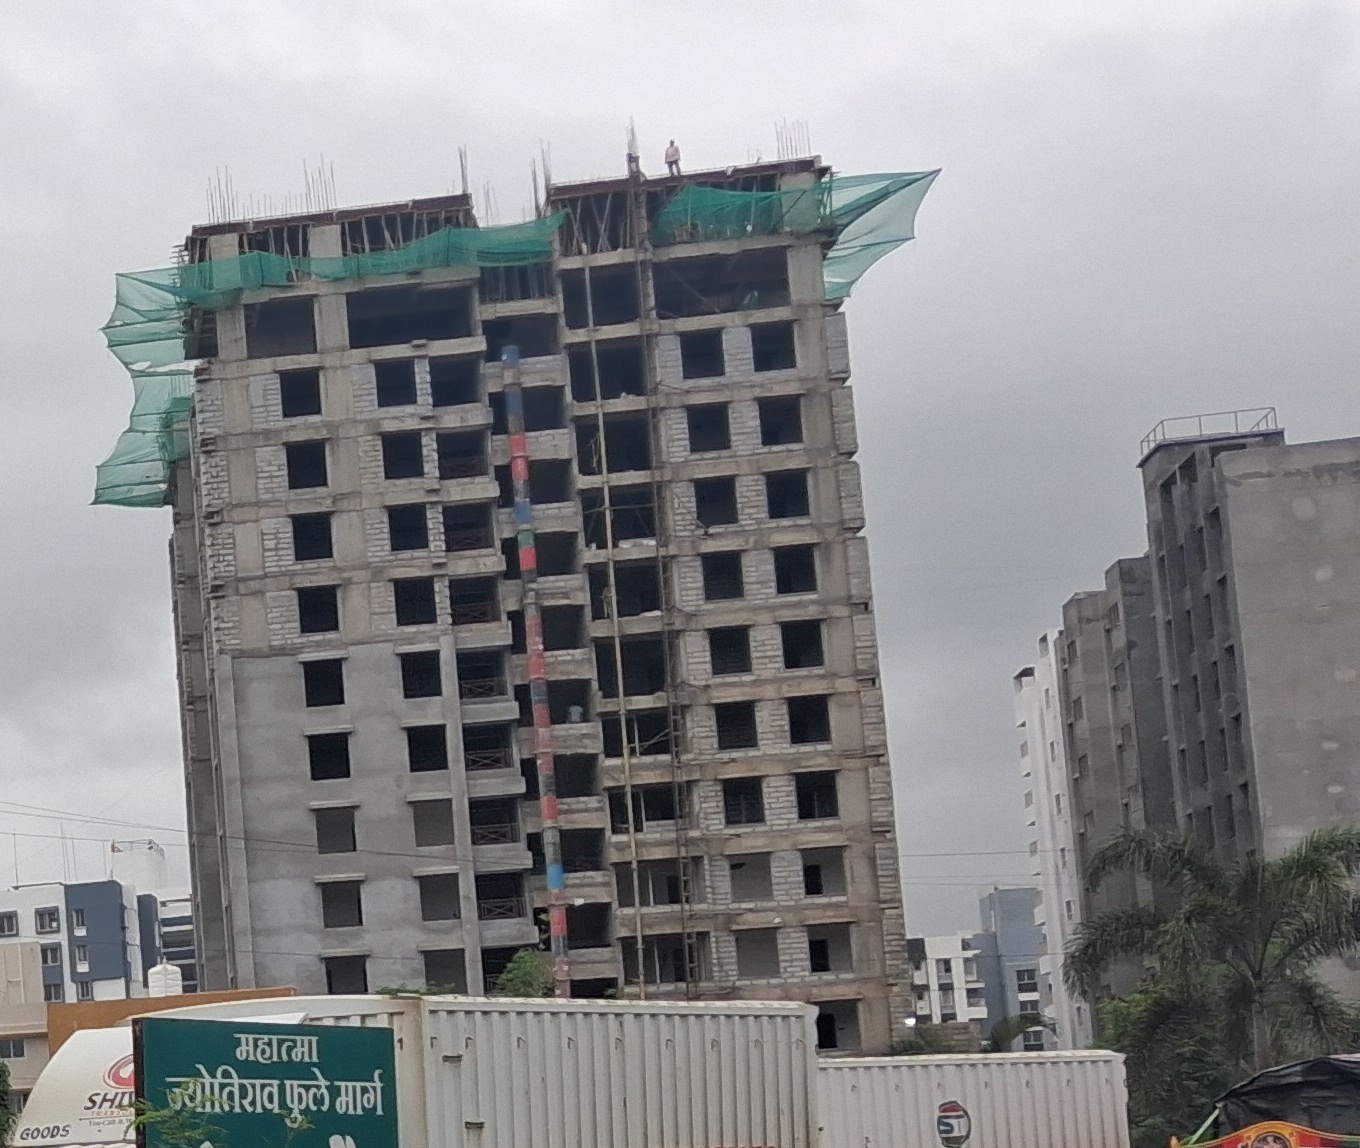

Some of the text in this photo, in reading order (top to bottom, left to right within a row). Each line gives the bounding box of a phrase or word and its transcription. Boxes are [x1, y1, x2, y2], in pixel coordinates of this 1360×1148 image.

[233, 1033, 319, 1064] महात्मा
[165, 1063, 384, 1128] ज्योतिराव फुले मार्ग
[20, 1124, 71, 1141] GOODS
